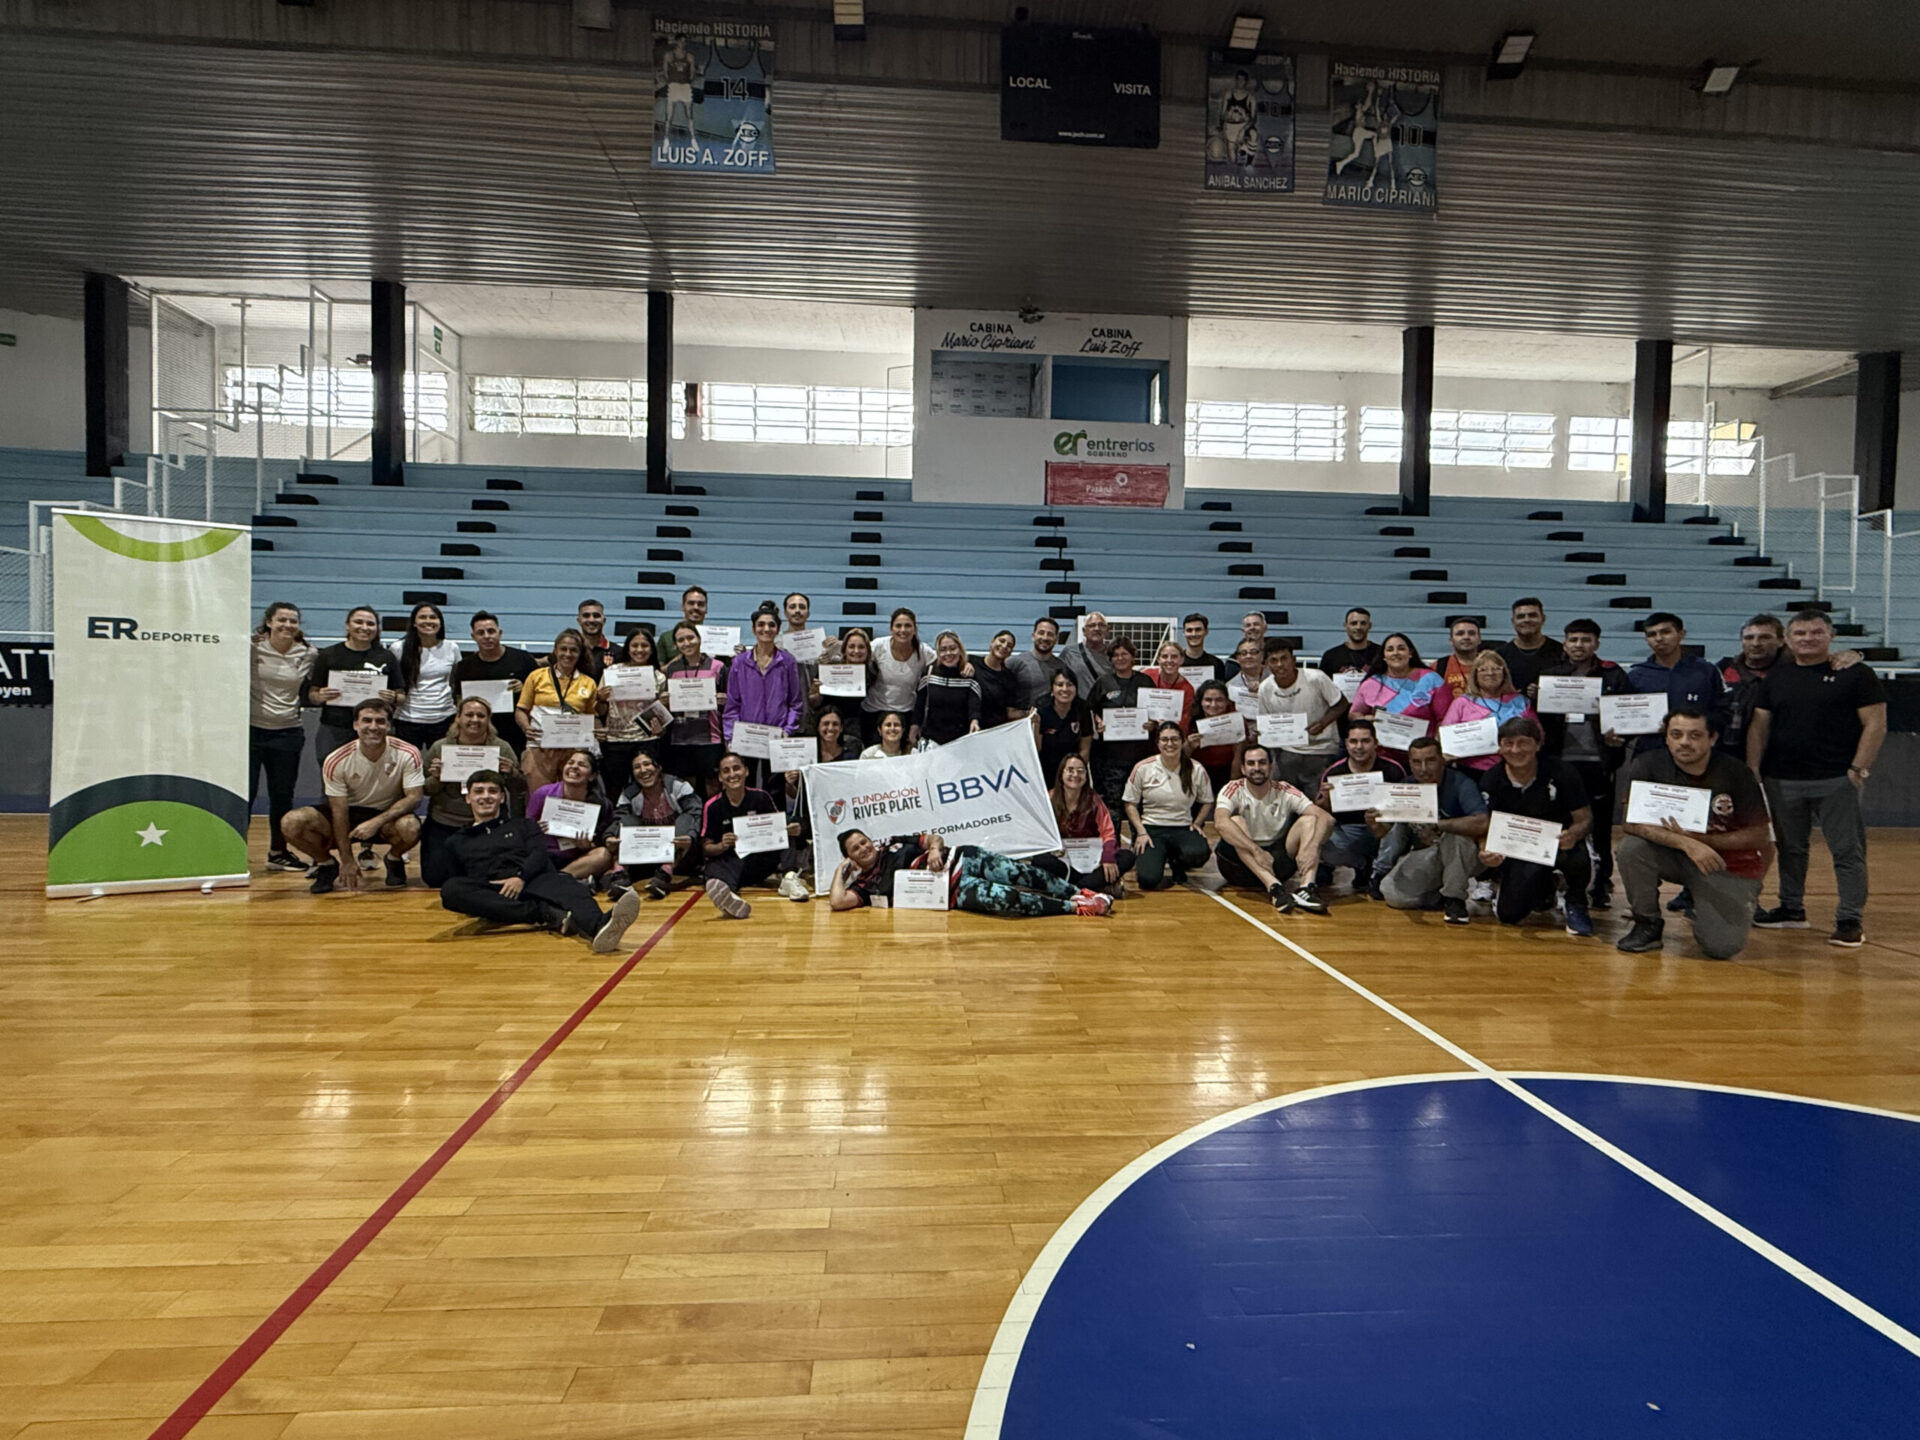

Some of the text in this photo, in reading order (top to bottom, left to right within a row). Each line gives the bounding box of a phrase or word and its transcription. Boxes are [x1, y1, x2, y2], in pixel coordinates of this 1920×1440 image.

[655, 19, 771, 37] Haciendo HISTORIA
[1009, 76, 1052, 89] LOCAL
[1334, 63, 1441, 83] Haciendo HISTORIA
[721, 76, 749, 102] 14
[1113, 83, 1152, 96] VISITA
[657, 146, 769, 166] LUIS A. ZOFF
[1243, 176, 1288, 190] SANCHEZ
[1327, 184, 1435, 206] MARIO CIPRIANI
[969, 322, 1014, 334] CABINA
[1091, 328, 1133, 339] CABINA
[941, 332, 1037, 352] Mario Cipriani
[1079, 338, 1144, 358] Luis Zoff
[87, 616, 220, 644] ER DEPORTES
[936, 764, 1029, 804] BBVA
[853, 795, 922, 821] RIVER PLATE
[930, 813, 1013, 835] FORMADORES
